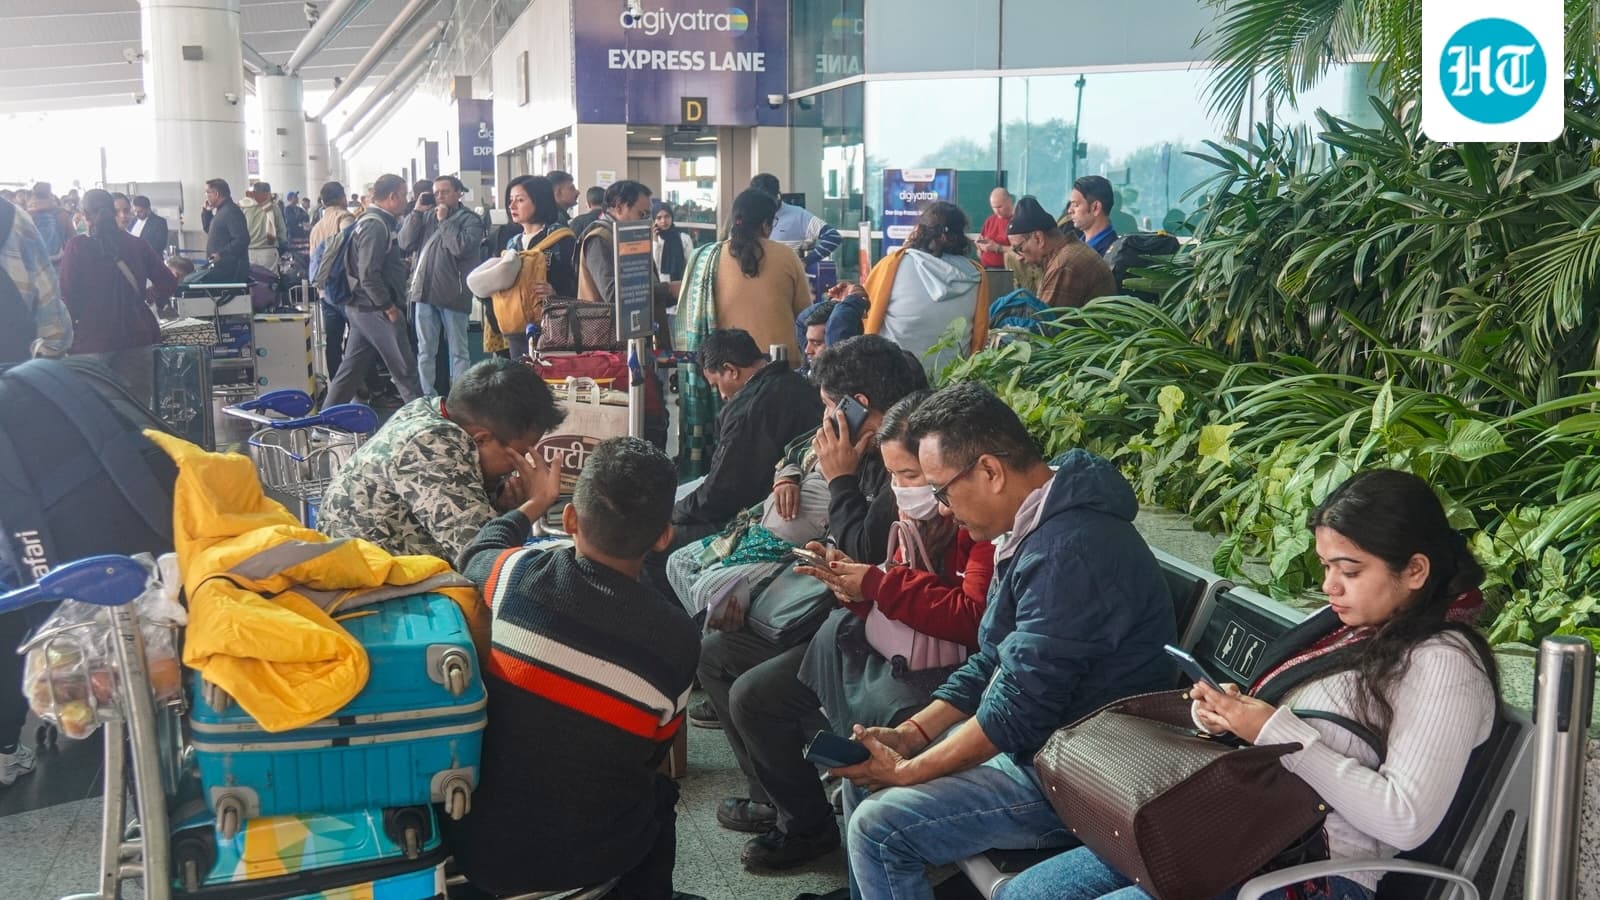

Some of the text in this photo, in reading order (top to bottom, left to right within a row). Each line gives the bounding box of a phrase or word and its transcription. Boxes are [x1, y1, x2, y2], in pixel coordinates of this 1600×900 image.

[608, 49, 766, 72] EXPRESS LANE
[686, 101, 702, 121] D
[899, 189, 933, 202] digiyatra
[543, 441, 593, 470] पाटी
[15, 530, 50, 578] afari
